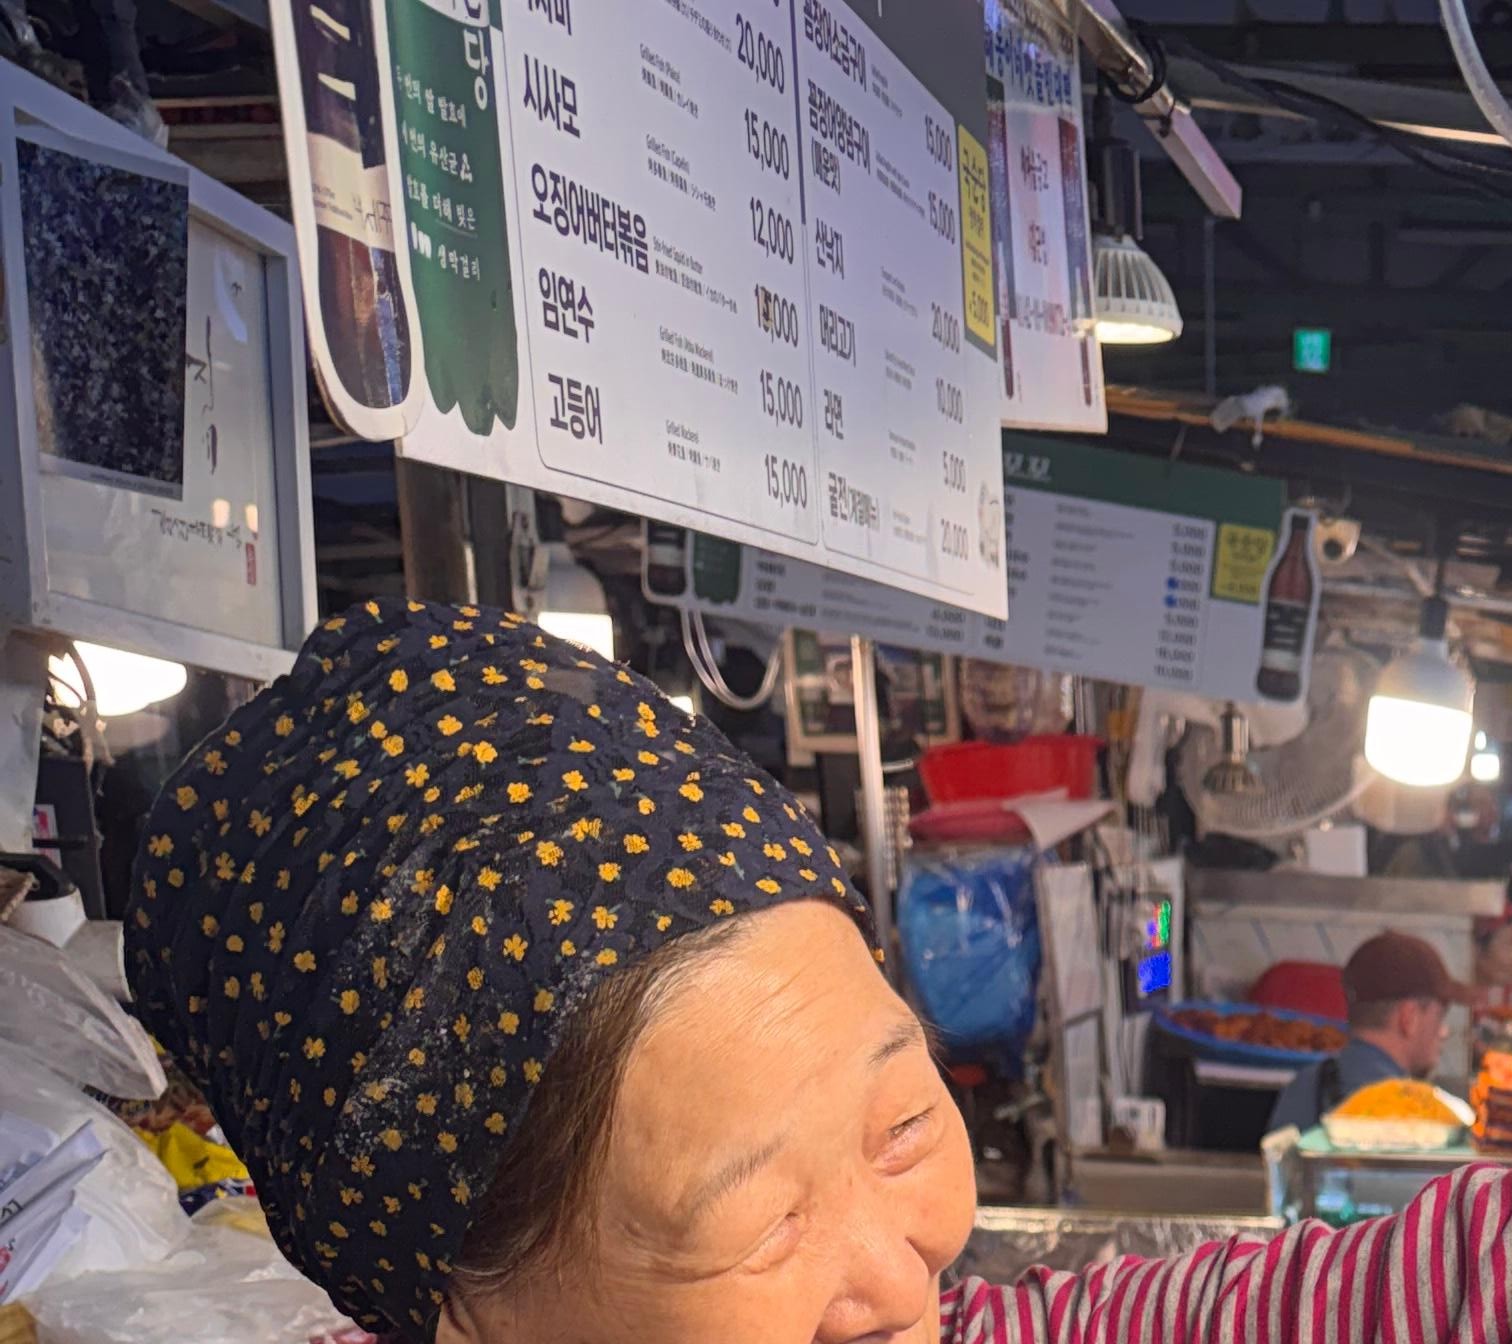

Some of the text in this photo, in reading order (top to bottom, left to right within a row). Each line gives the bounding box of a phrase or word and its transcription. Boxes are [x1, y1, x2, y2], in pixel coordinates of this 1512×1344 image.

[736, 12, 785, 95] 20,000
[523, 53, 581, 138] 시사모
[745, 108, 789, 180] 15,000
[808, 78, 871, 176] 꼼장어양념구이
[925, 114, 952, 173] 15,000
[811, 136, 841, 196] (매운맛)
[531, 162, 650, 274] 오징어버터볶음
[750, 196, 795, 266] 12,000
[815, 217, 845, 280] 산낙지
[928, 189, 956, 246] 15,000
[538, 267, 595, 343] 임연수
[820, 303, 856, 368] 머리고기
[931, 301, 960, 354] 20,000
[548, 372, 603, 446] 고등어
[760, 368, 803, 429] 15,000
[823, 388, 844, 440] 라면
[936, 377, 963, 424] 10,000
[764, 453, 808, 509] 15,000
[943, 451, 966, 493] 5,000
[941, 518, 969, 561] 20,000
